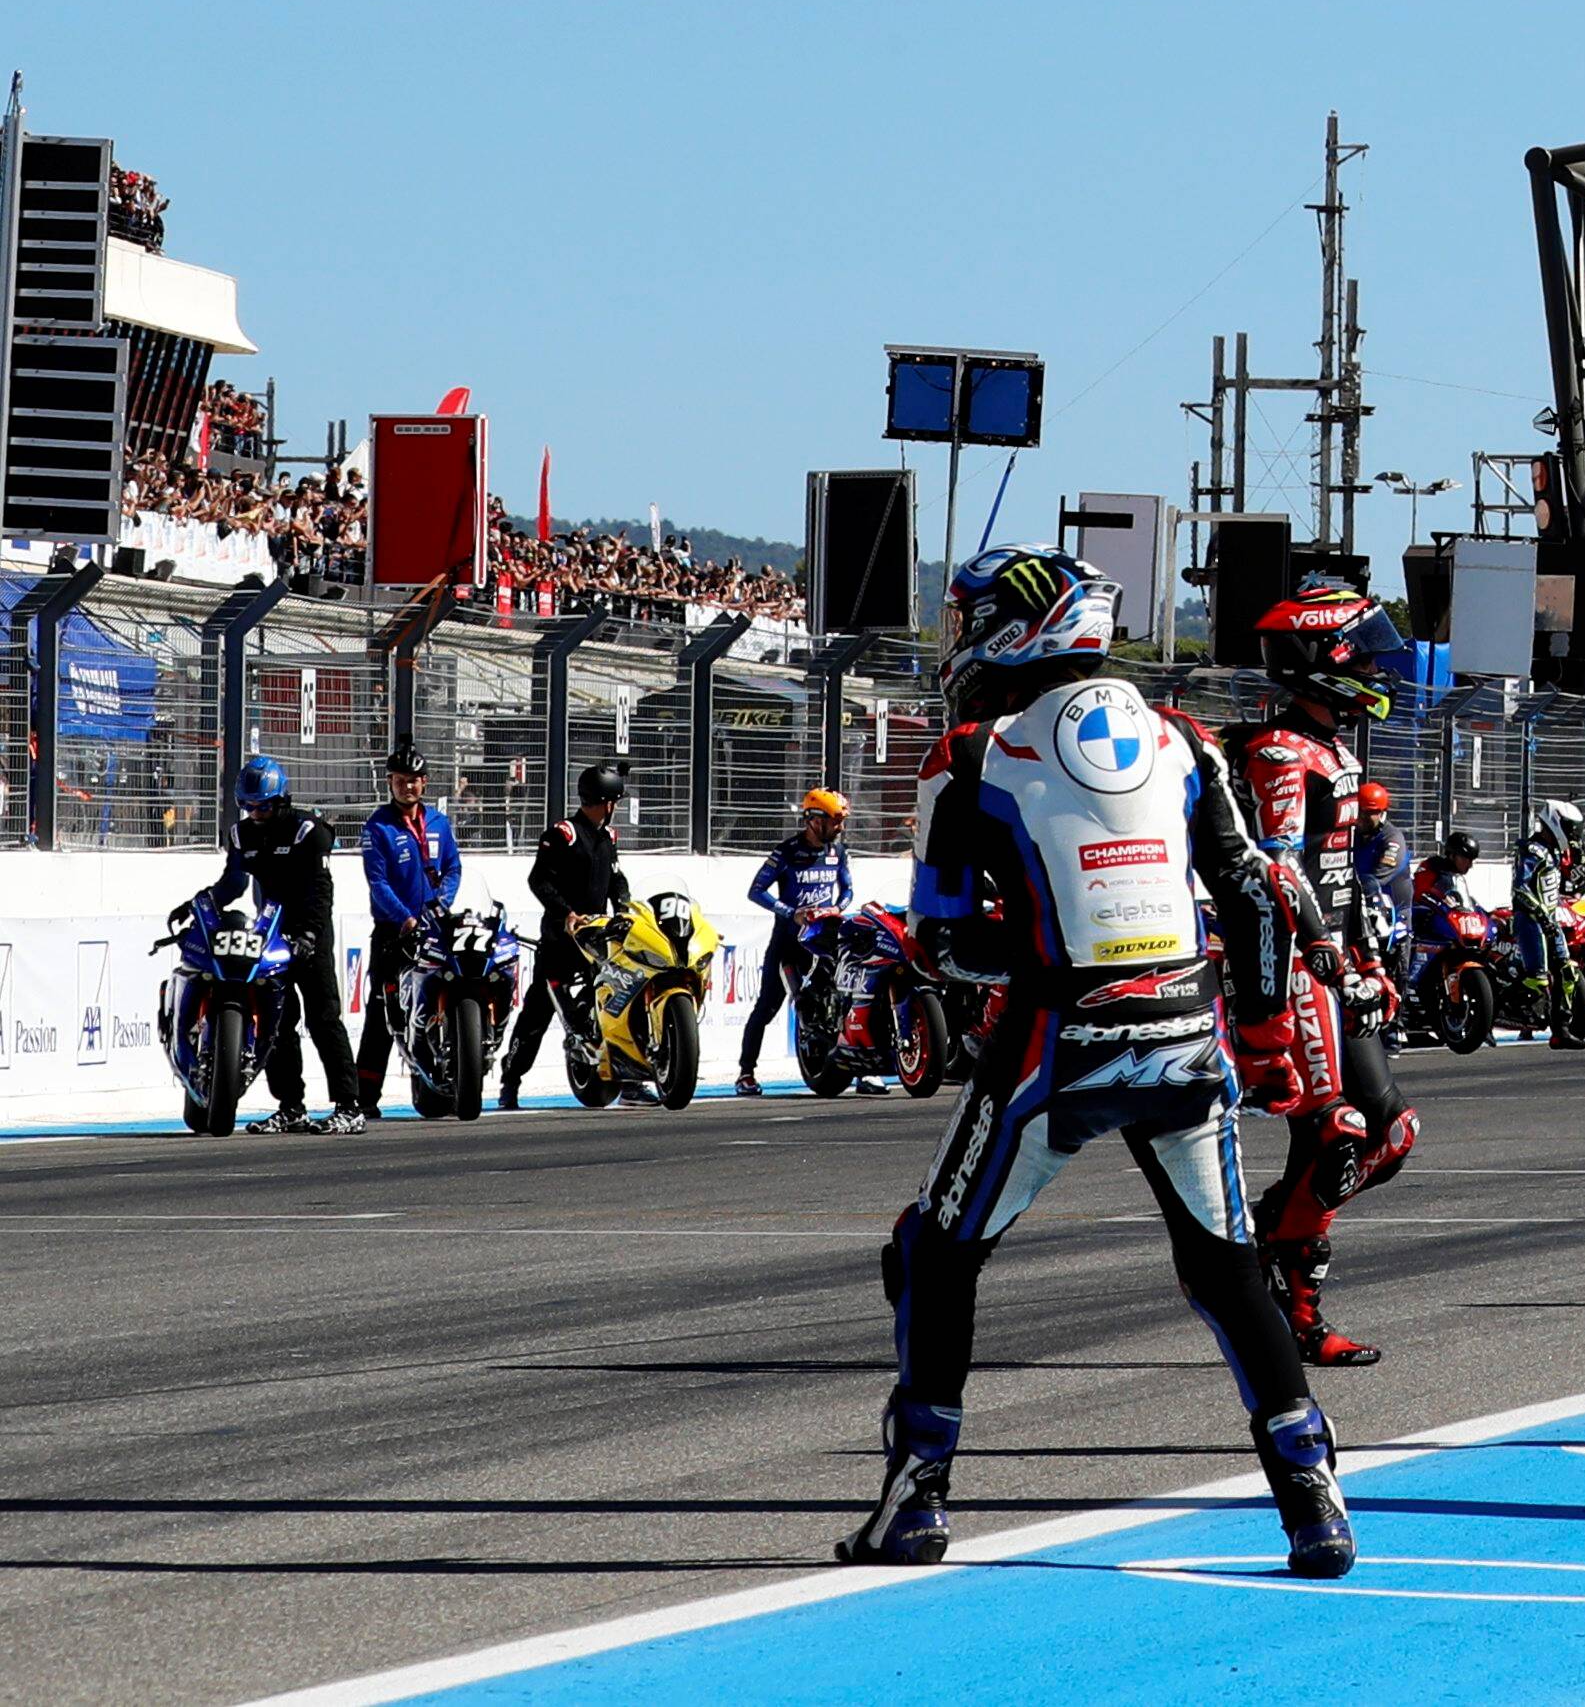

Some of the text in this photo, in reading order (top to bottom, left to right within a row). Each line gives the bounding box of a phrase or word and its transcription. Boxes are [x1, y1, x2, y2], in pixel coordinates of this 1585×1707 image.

[986, 624, 1023, 656] SHOEI
[1066, 690, 1138, 722] BMW
[1083, 843, 1165, 861] CHAMPION
[659, 896, 692, 921] 90
[1096, 899, 1173, 922] alpha
[213, 930, 263, 959] 333
[451, 926, 494, 952] 77
[1113, 940, 1177, 955] DUNLOP
[15, 1017, 57, 1054] Passion
[112, 1012, 152, 1049] Passion
[1059, 1011, 1215, 1047] alpinestars
[1290, 970, 1332, 1096] SUZUKI
[937, 1093, 994, 1230] alpinestars
